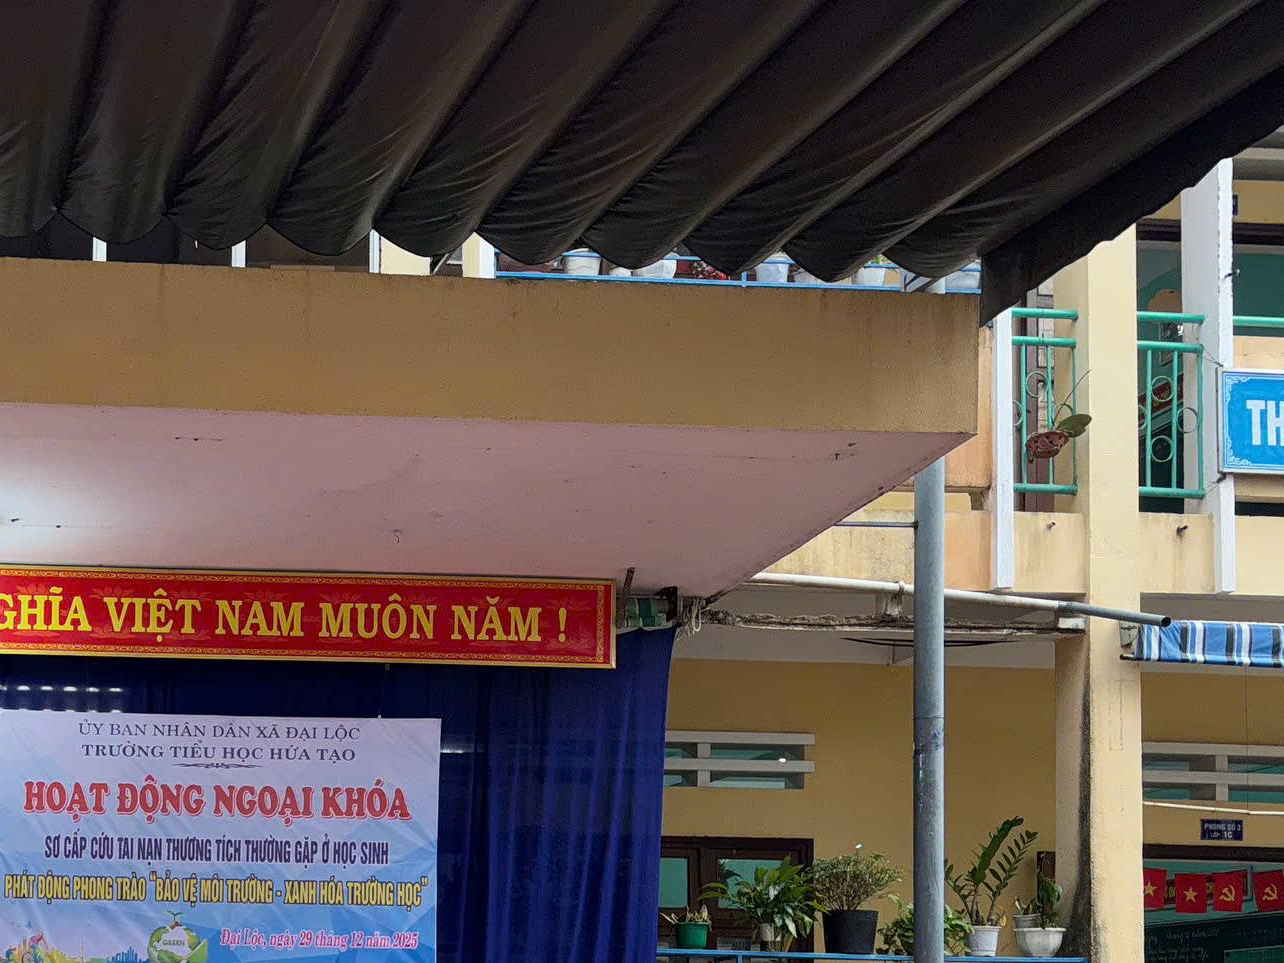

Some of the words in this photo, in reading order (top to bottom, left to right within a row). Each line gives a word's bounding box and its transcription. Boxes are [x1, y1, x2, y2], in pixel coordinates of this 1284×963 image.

[103, 589, 201, 641] VIỆT
[215, 599, 304, 638] NAM
[318, 594, 438, 640] MUÔN
[450, 595, 542, 642] NĂM
[556, 609, 568, 642] !
[79, 719, 103, 736] ỦY
[109, 723, 147, 736] BAN
[153, 721, 206, 737] NHÂN
[212, 723, 250, 737] DÂN
[256, 724, 280, 739] XÃ
[286, 727, 317, 742] ĐẠI
[324, 725, 360, 742] LỘC
[82, 740, 164, 758] TRƯỜNG
[171, 738, 215, 759] TIỂU
[222, 747, 263, 762] HỌC
[270, 745, 311, 760] HỨA
[316, 749, 356, 764] TẠO
[23, 781, 111, 822] HOẠT
[117, 774, 206, 824] ĐỘNG
[213, 784, 315, 826] NGOẠI
[321, 778, 412, 820] KHÓA
[45, 834, 60, 859] SƠ
[64, 828, 87, 859] CẤP
[91, 832, 114, 860] CỨU
[117, 837, 133, 860] TAI
[138, 838, 163, 865] NẠN
[166, 838, 211, 862] THƯƠNG
[216, 834, 241, 863] TÍCH
[245, 834, 291, 863] THƯỜNG
[295, 836, 317, 868] GẶP
[322, 833, 330, 863] Ở
[333, 842, 357, 868] HỌC
[361, 842, 388, 864] SINH
[4, 870, 35, 898] PHÁT
[37, 870, 70, 905] ĐỘNG
[73, 876, 113, 900] PHONG
[116, 872, 146, 901] TRÀO
[183, 873, 198, 907] VỆ
[200, 873, 223, 902] MÔI
[226, 874, 273, 903] TRƯỜNG
[284, 880, 316, 905] XANH
[319, 876, 344, 905] HÓA
[346, 876, 394, 906] TRƯỜNG
[162, 939, 185, 947] GREEN
[220, 928, 242, 951] Đại
[244, 929, 268, 951] Lộc,
[270, 931, 297, 951] ngày
[299, 932, 312, 946] 29
[315, 932, 348, 951] tháng
[350, 932, 363, 947] 12
[365, 932, 391, 947] năm
[393, 933, 418, 949] 2025
